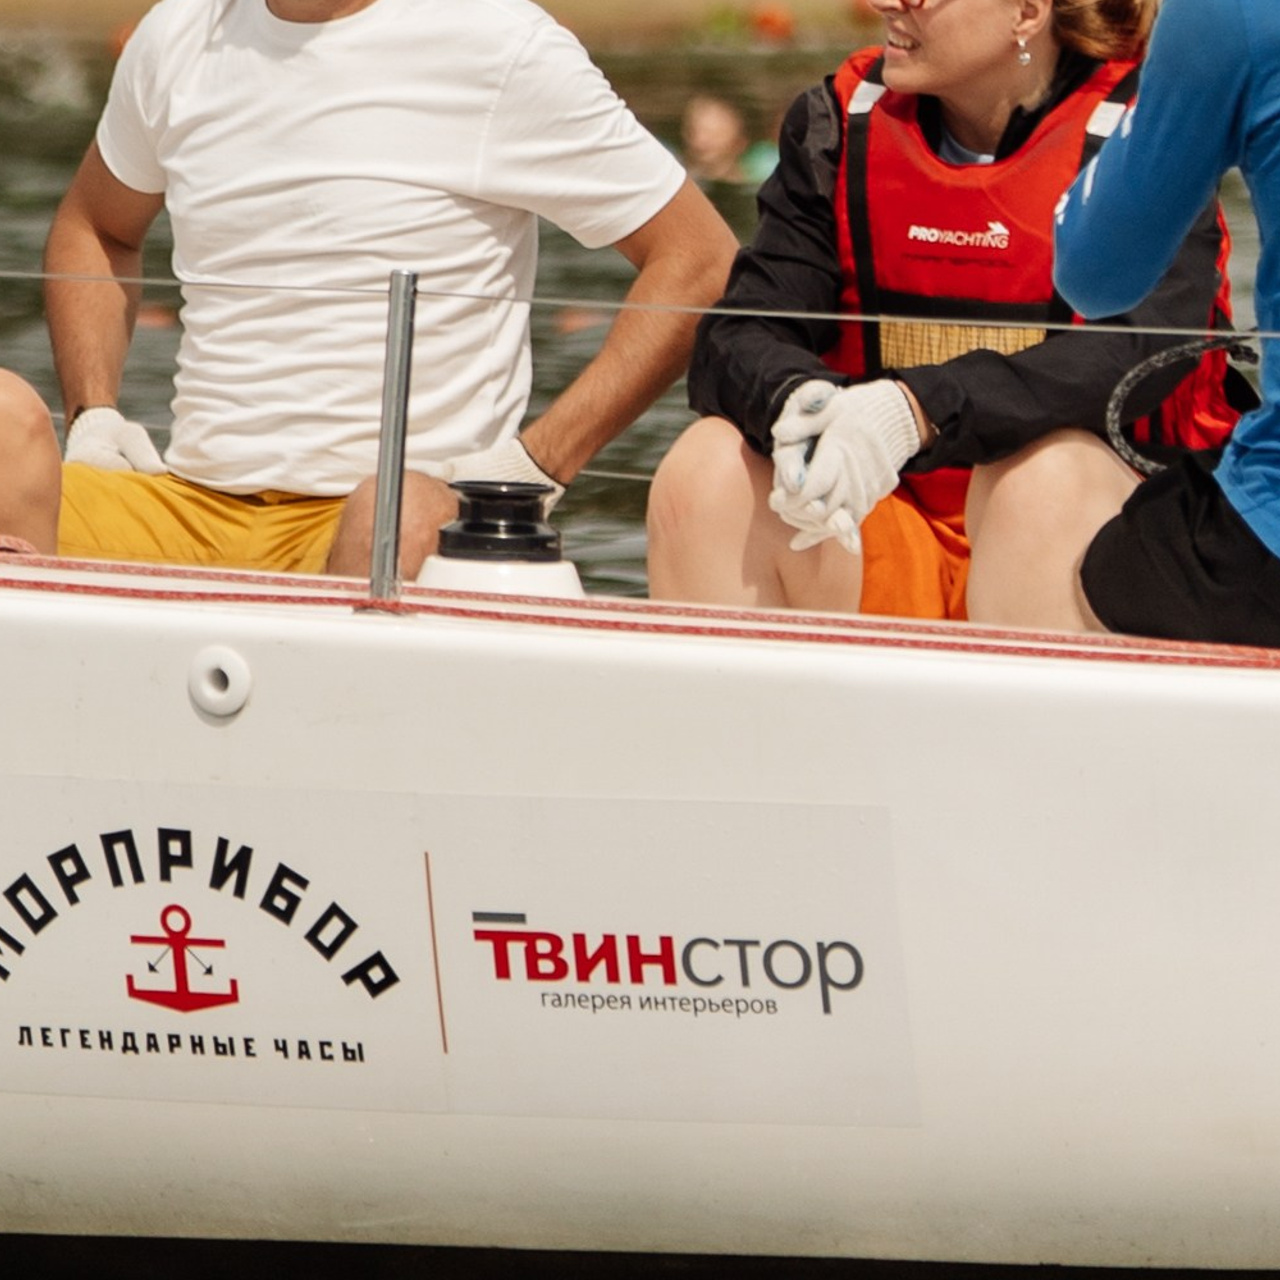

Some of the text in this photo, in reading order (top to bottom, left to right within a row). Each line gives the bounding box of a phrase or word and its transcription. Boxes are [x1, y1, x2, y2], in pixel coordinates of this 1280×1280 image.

[907, 224, 1010, 250] PROYACHTING
[540, 991, 779, 1018] галерея интерьеров
[18, 1025, 366, 1063] ЛЕГЕНДАРНЫЕ ЧАСЫ
